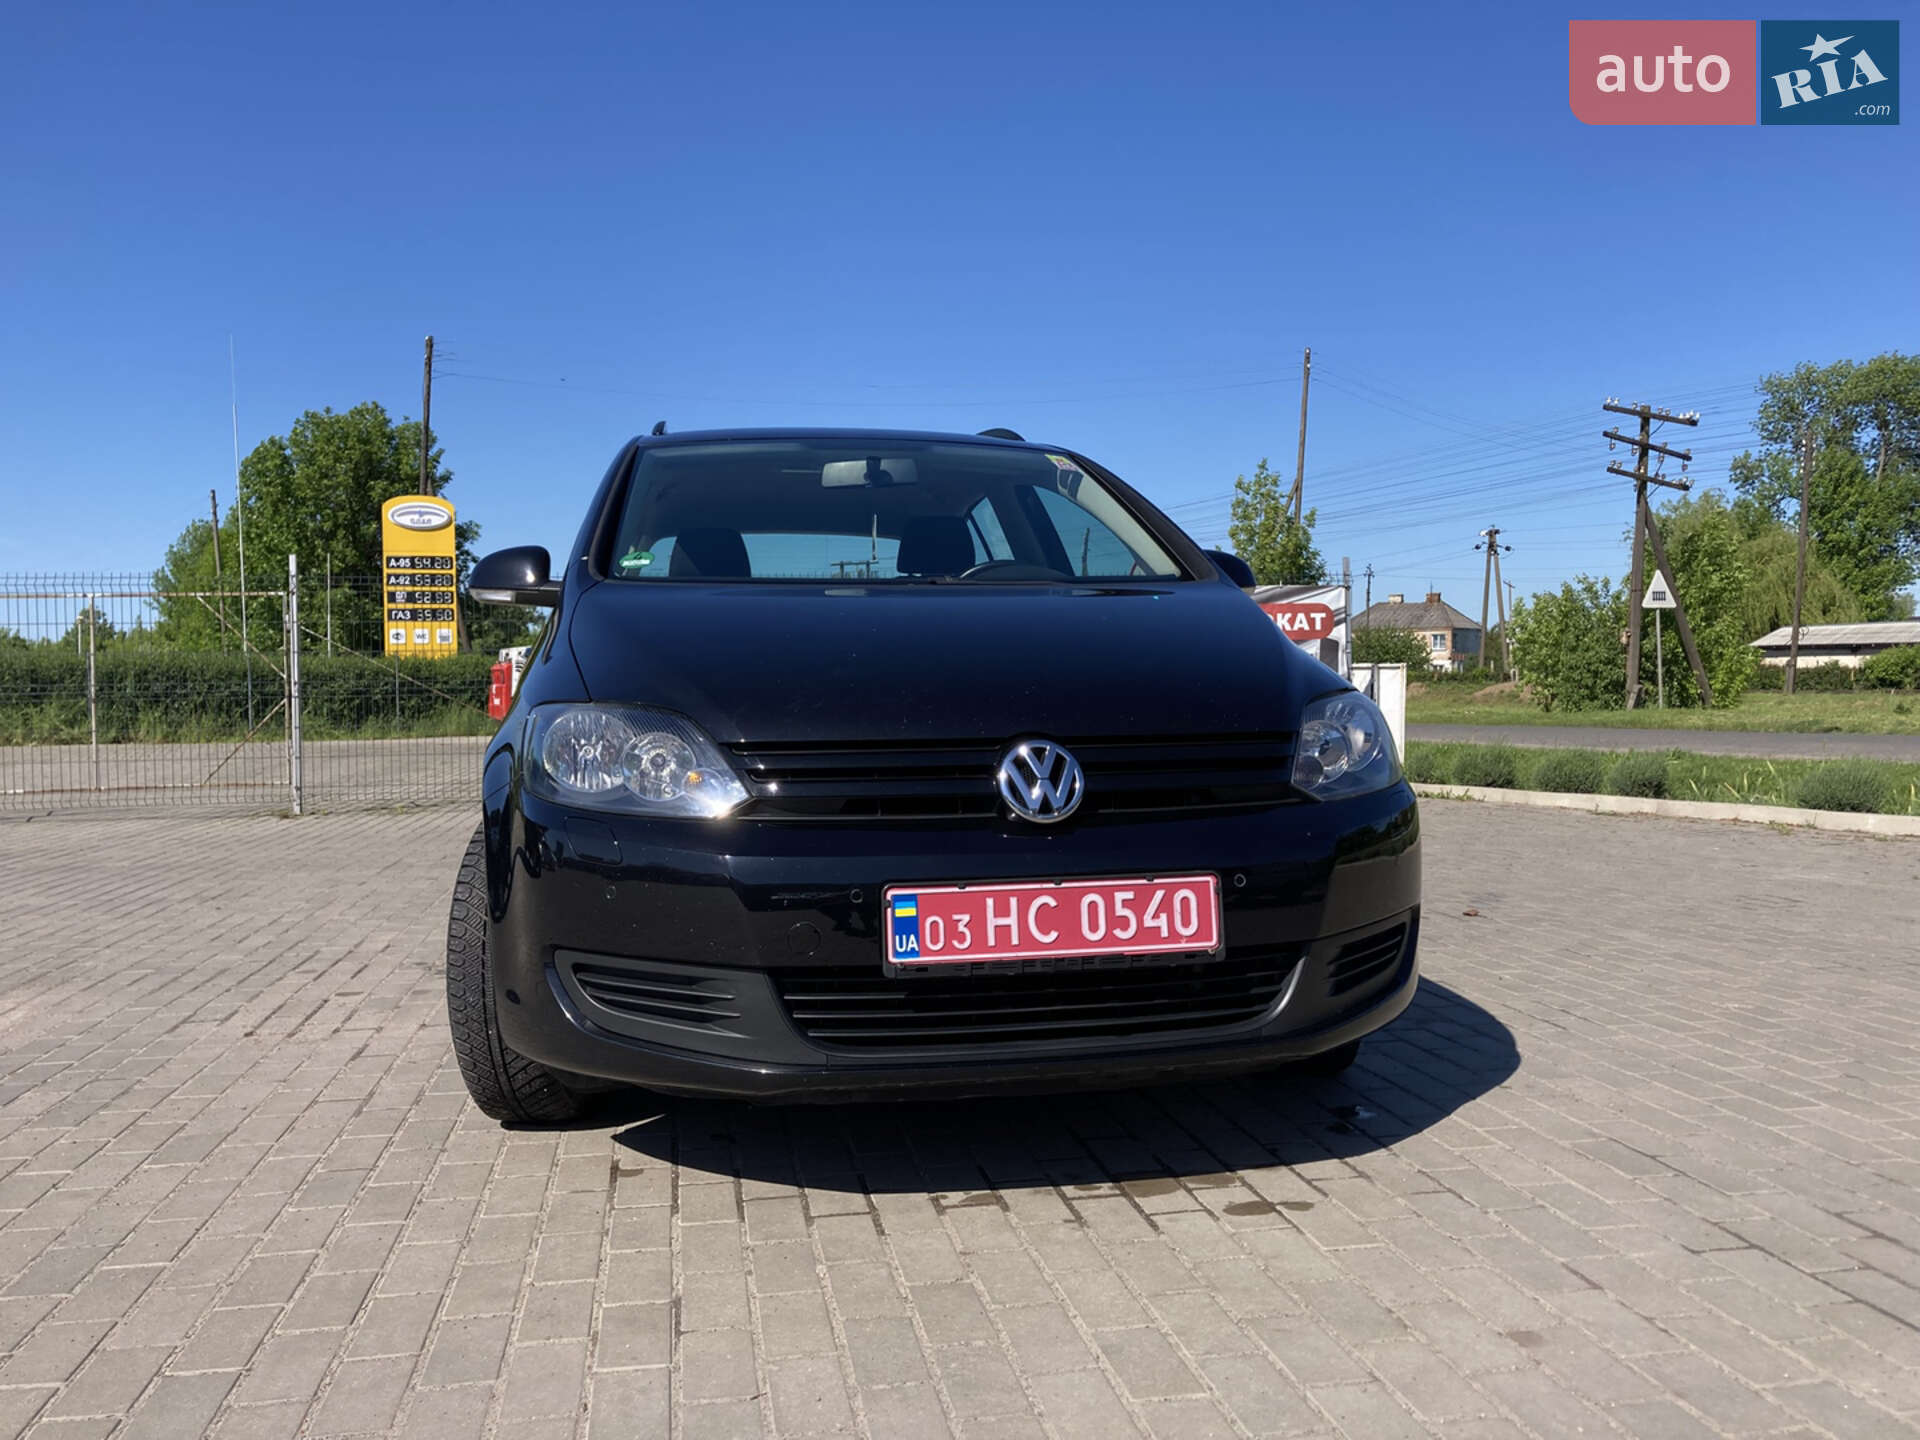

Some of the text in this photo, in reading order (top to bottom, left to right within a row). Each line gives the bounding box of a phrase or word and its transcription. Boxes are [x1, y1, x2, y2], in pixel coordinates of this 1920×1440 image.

[391, 610, 411, 620] ГАЗ
[1267, 612, 1327, 631] КАТ
[924, 888, 1199, 951] 03 HC 0540
[895, 934, 919, 953] UA
